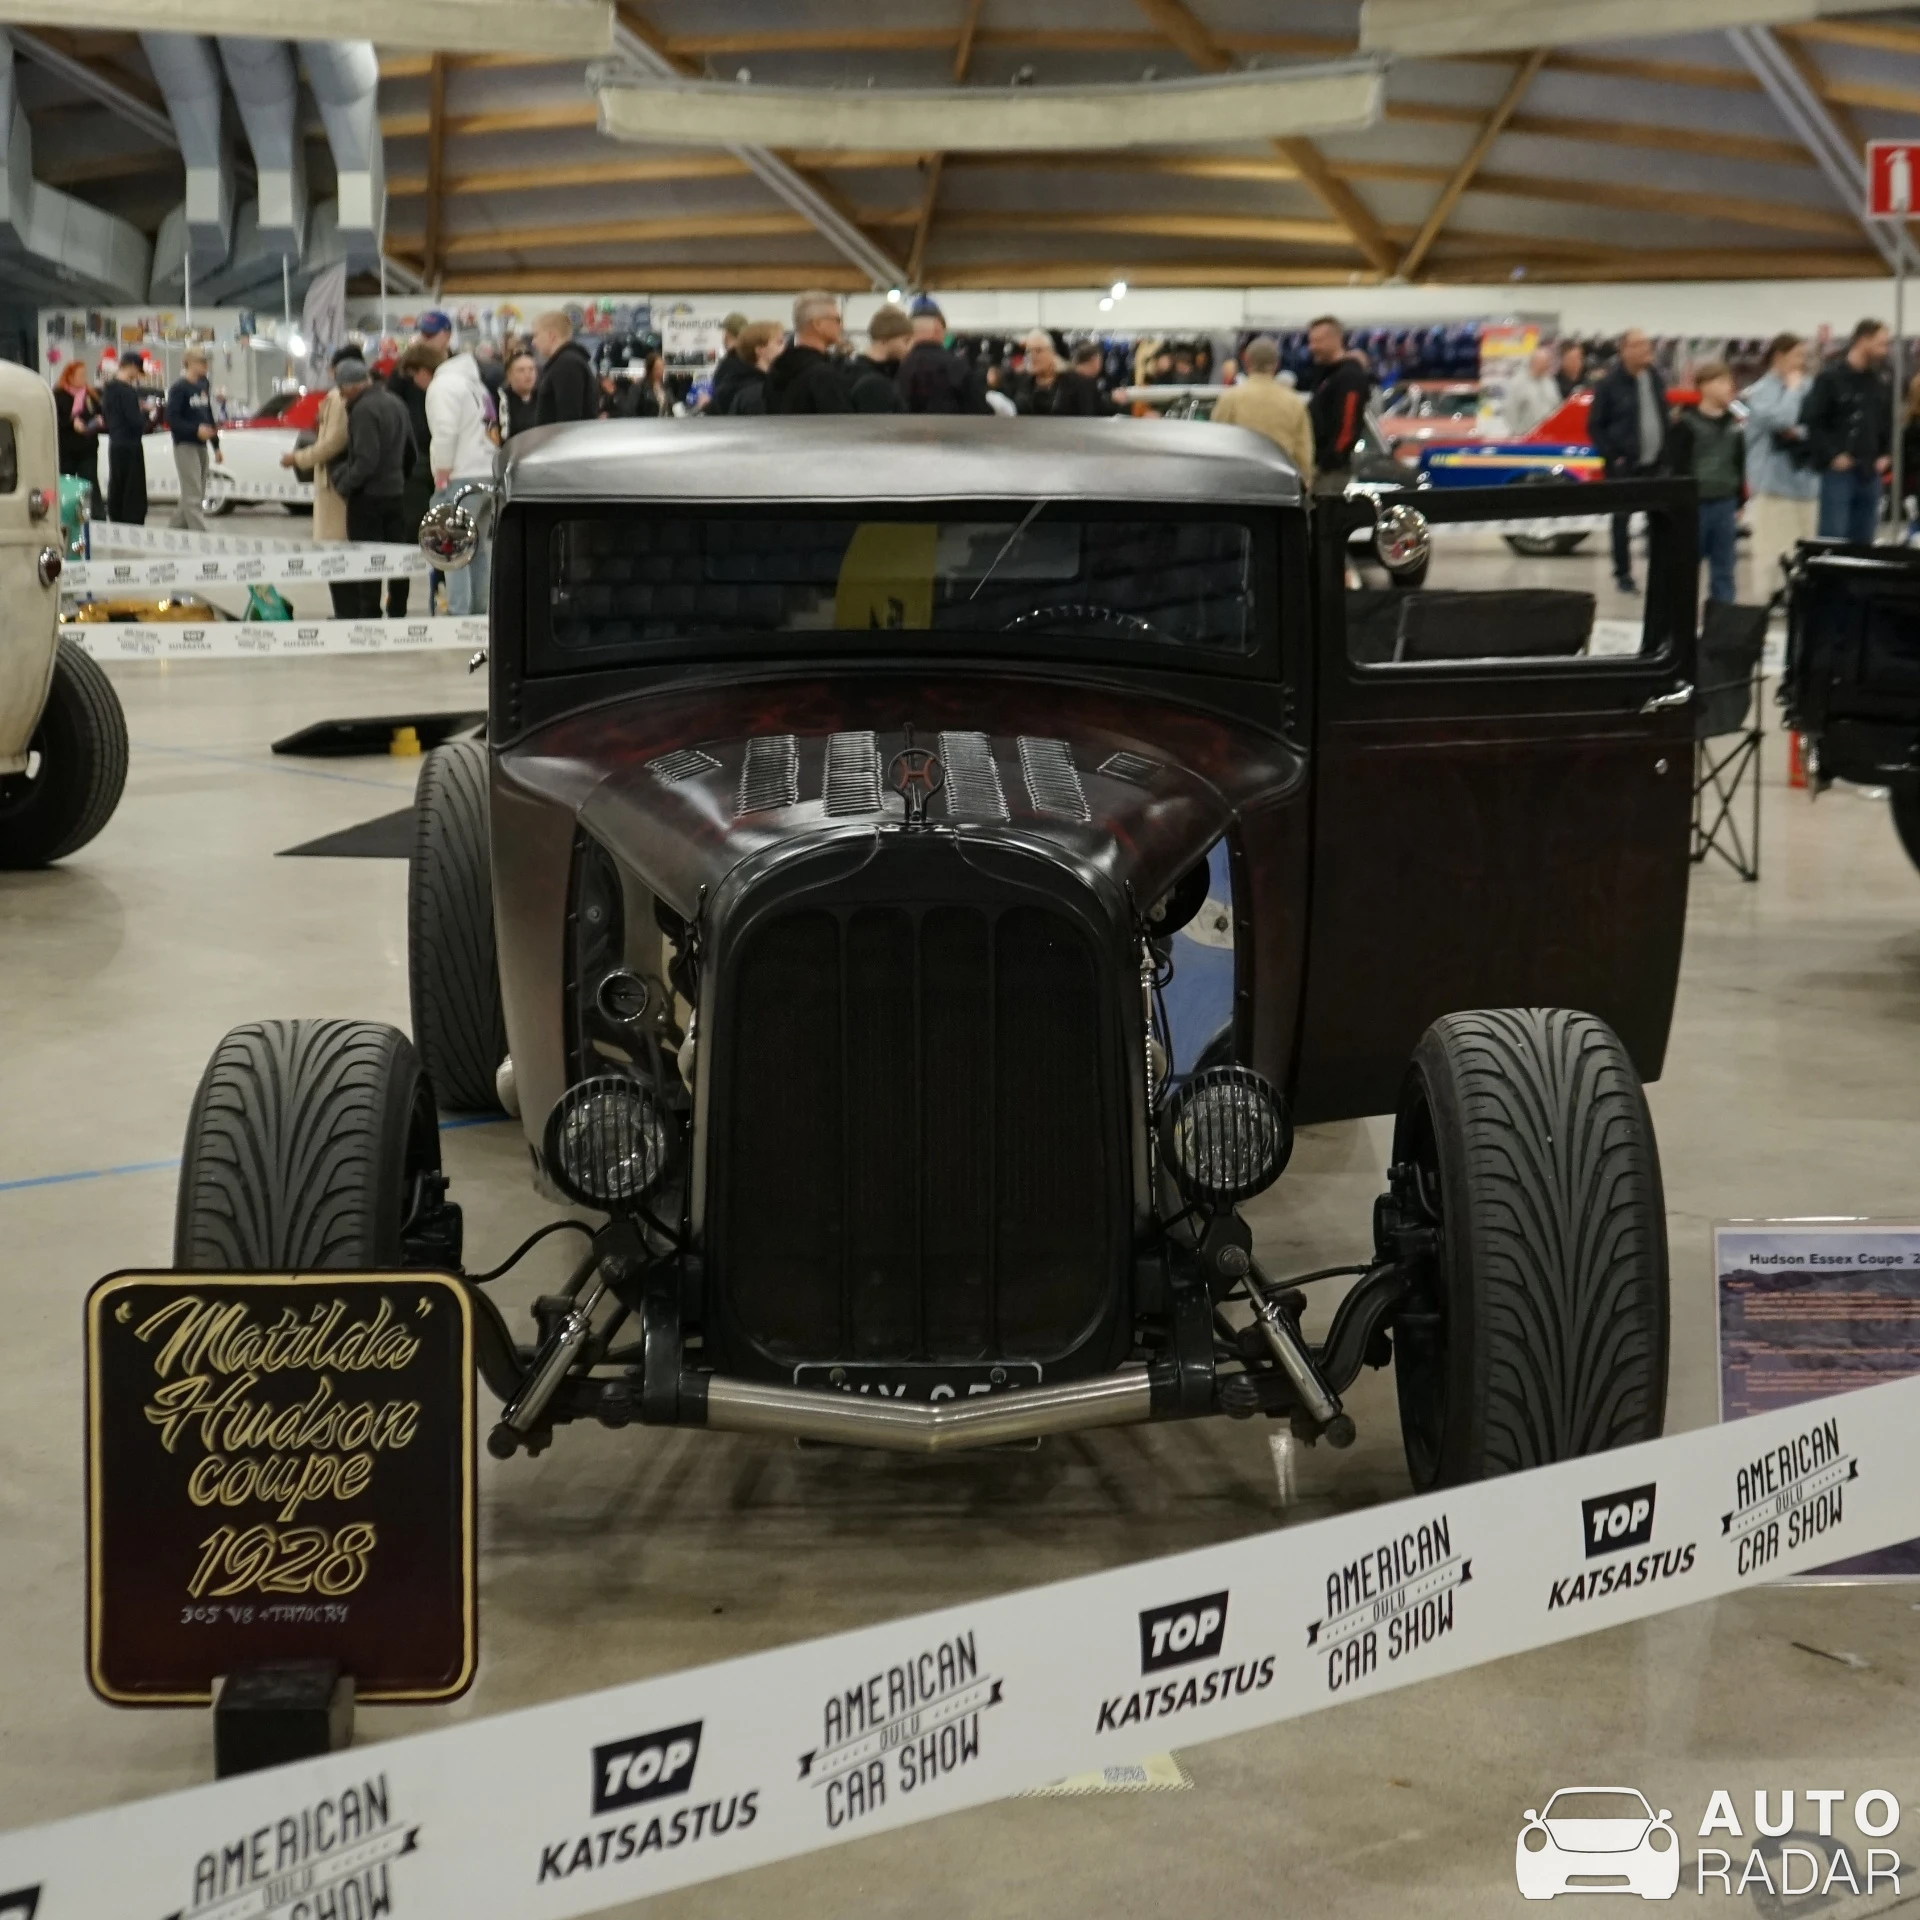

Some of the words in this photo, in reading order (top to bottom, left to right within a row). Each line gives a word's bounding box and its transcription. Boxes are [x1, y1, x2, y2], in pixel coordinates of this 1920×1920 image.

[1750, 1253, 1805, 1265] Hudson
[1810, 1253, 1853, 1265] Essex
[1858, 1253, 1904, 1267] Coupe
[144, 1372, 421, 1453] Hudson
[188, 1452, 375, 1522] coupe
[1736, 1417, 1840, 1510] AMERICAN
[1775, 1485, 1803, 1511] OULU
[1592, 1498, 1651, 1543] TOP
[1738, 1522, 1779, 1576] CAR
[1787, 1485, 1843, 1549] SHOW
[187, 1523, 377, 1599] 1928
[1326, 1513, 1452, 1618] AMERICAN
[1547, 1542, 1697, 1611] KATSASTUS
[180, 1605, 220, 1624] 305
[226, 1605, 255, 1624] V8
[1149, 1605, 1222, 1658] TOP
[1328, 1632, 1378, 1691] CAR
[1388, 1590, 1454, 1661] SHOW
[1373, 1590, 1406, 1622] OULU
[823, 1629, 977, 1748] AMERICAN
[1095, 1655, 1276, 1735] KATSASTUS
[603, 1737, 695, 1797] TOP
[879, 1712, 922, 1752] OULU
[825, 1760, 887, 1829] CAR
[900, 1713, 980, 1794] SHOW
[192, 1772, 390, 1908] AMERICAN
[536, 1788, 760, 1885] KATSASTUS
